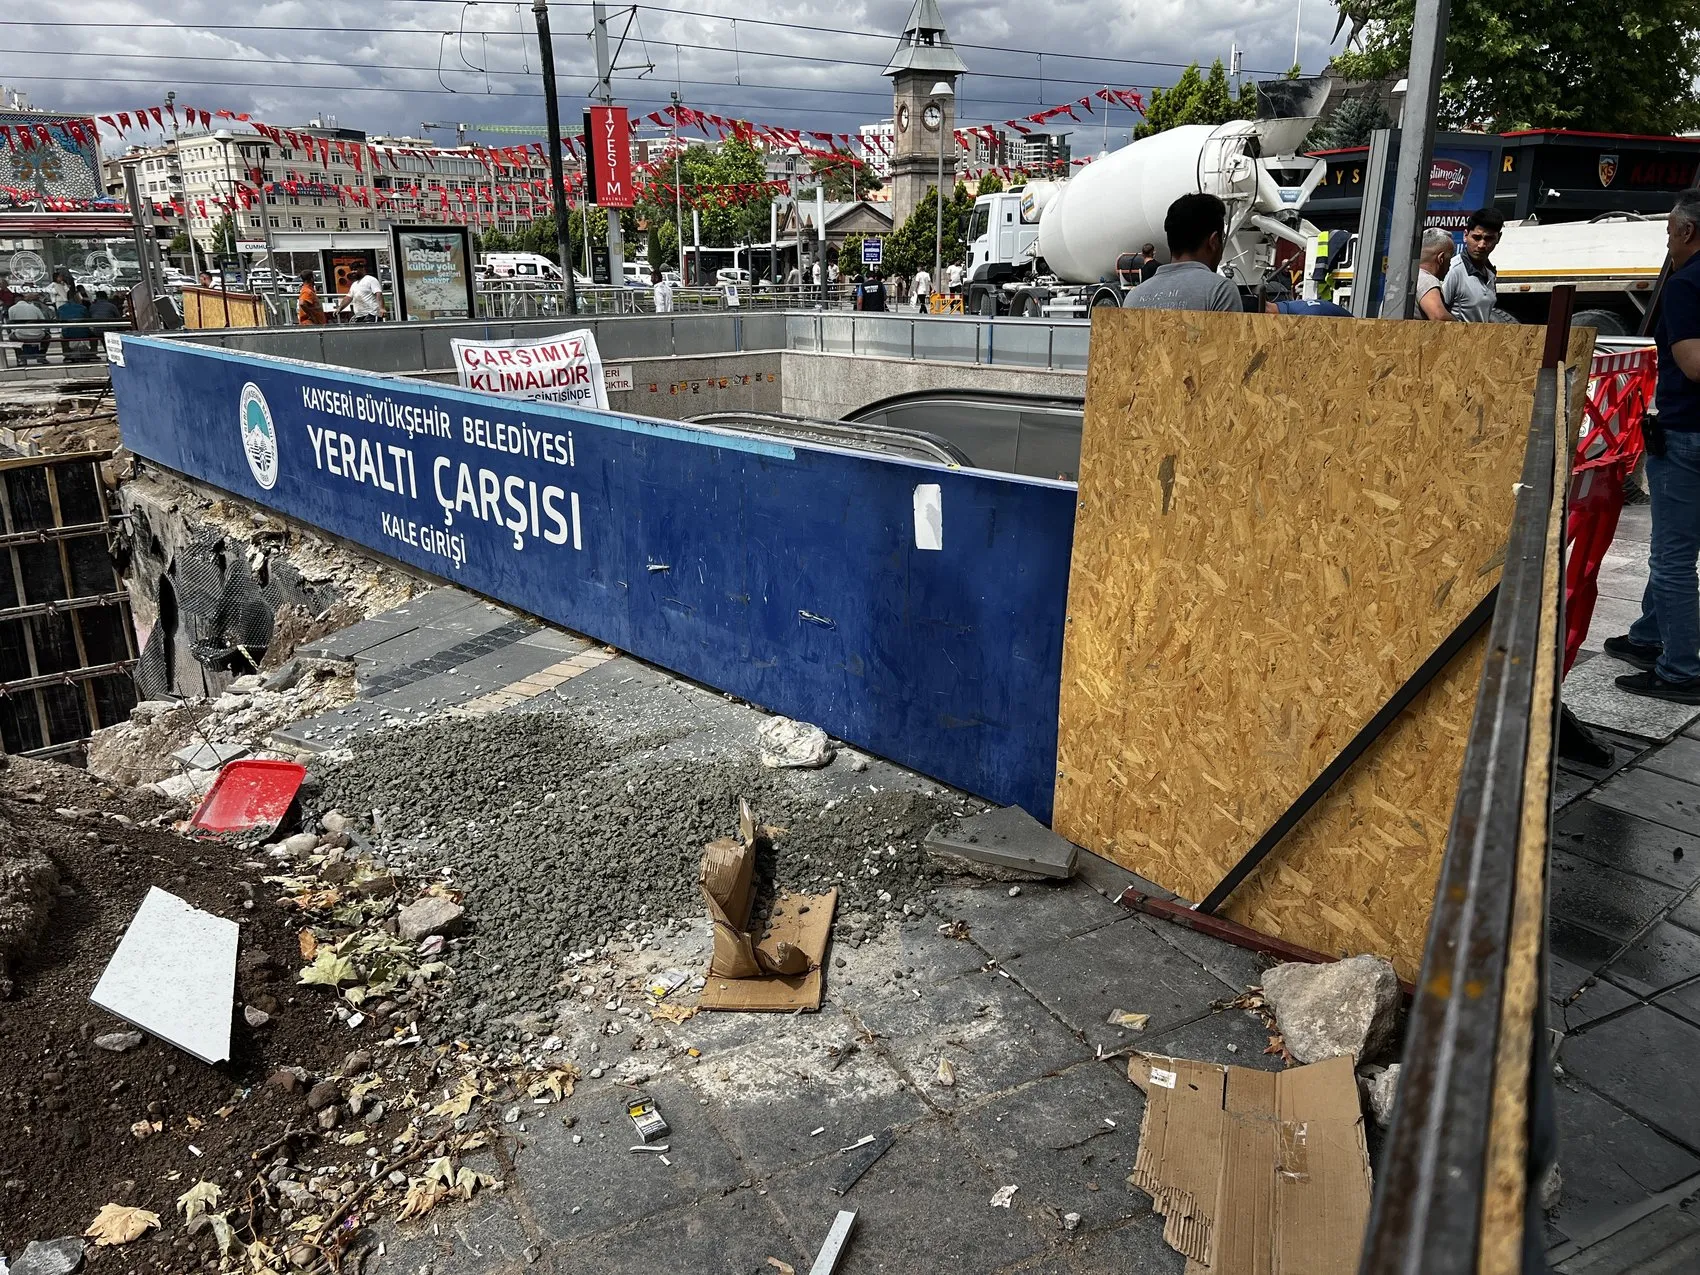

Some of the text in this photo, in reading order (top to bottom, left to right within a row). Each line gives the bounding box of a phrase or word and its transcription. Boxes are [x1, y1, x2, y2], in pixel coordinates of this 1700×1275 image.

[407, 262, 456, 273] kültür yolu
[464, 341, 585, 370] ÇARŞIMIZ
[470, 365, 590, 392] KLİMALIDIR
[603, 368, 620, 377] ERİ
[302, 386, 575, 467] KAYSERİ BÜYÜKŞEHİR BELEDİYESİ
[306, 424, 582, 551] YERALTI ÇARŞISI
[381, 511, 467, 570] KALE GİRİŞİ
